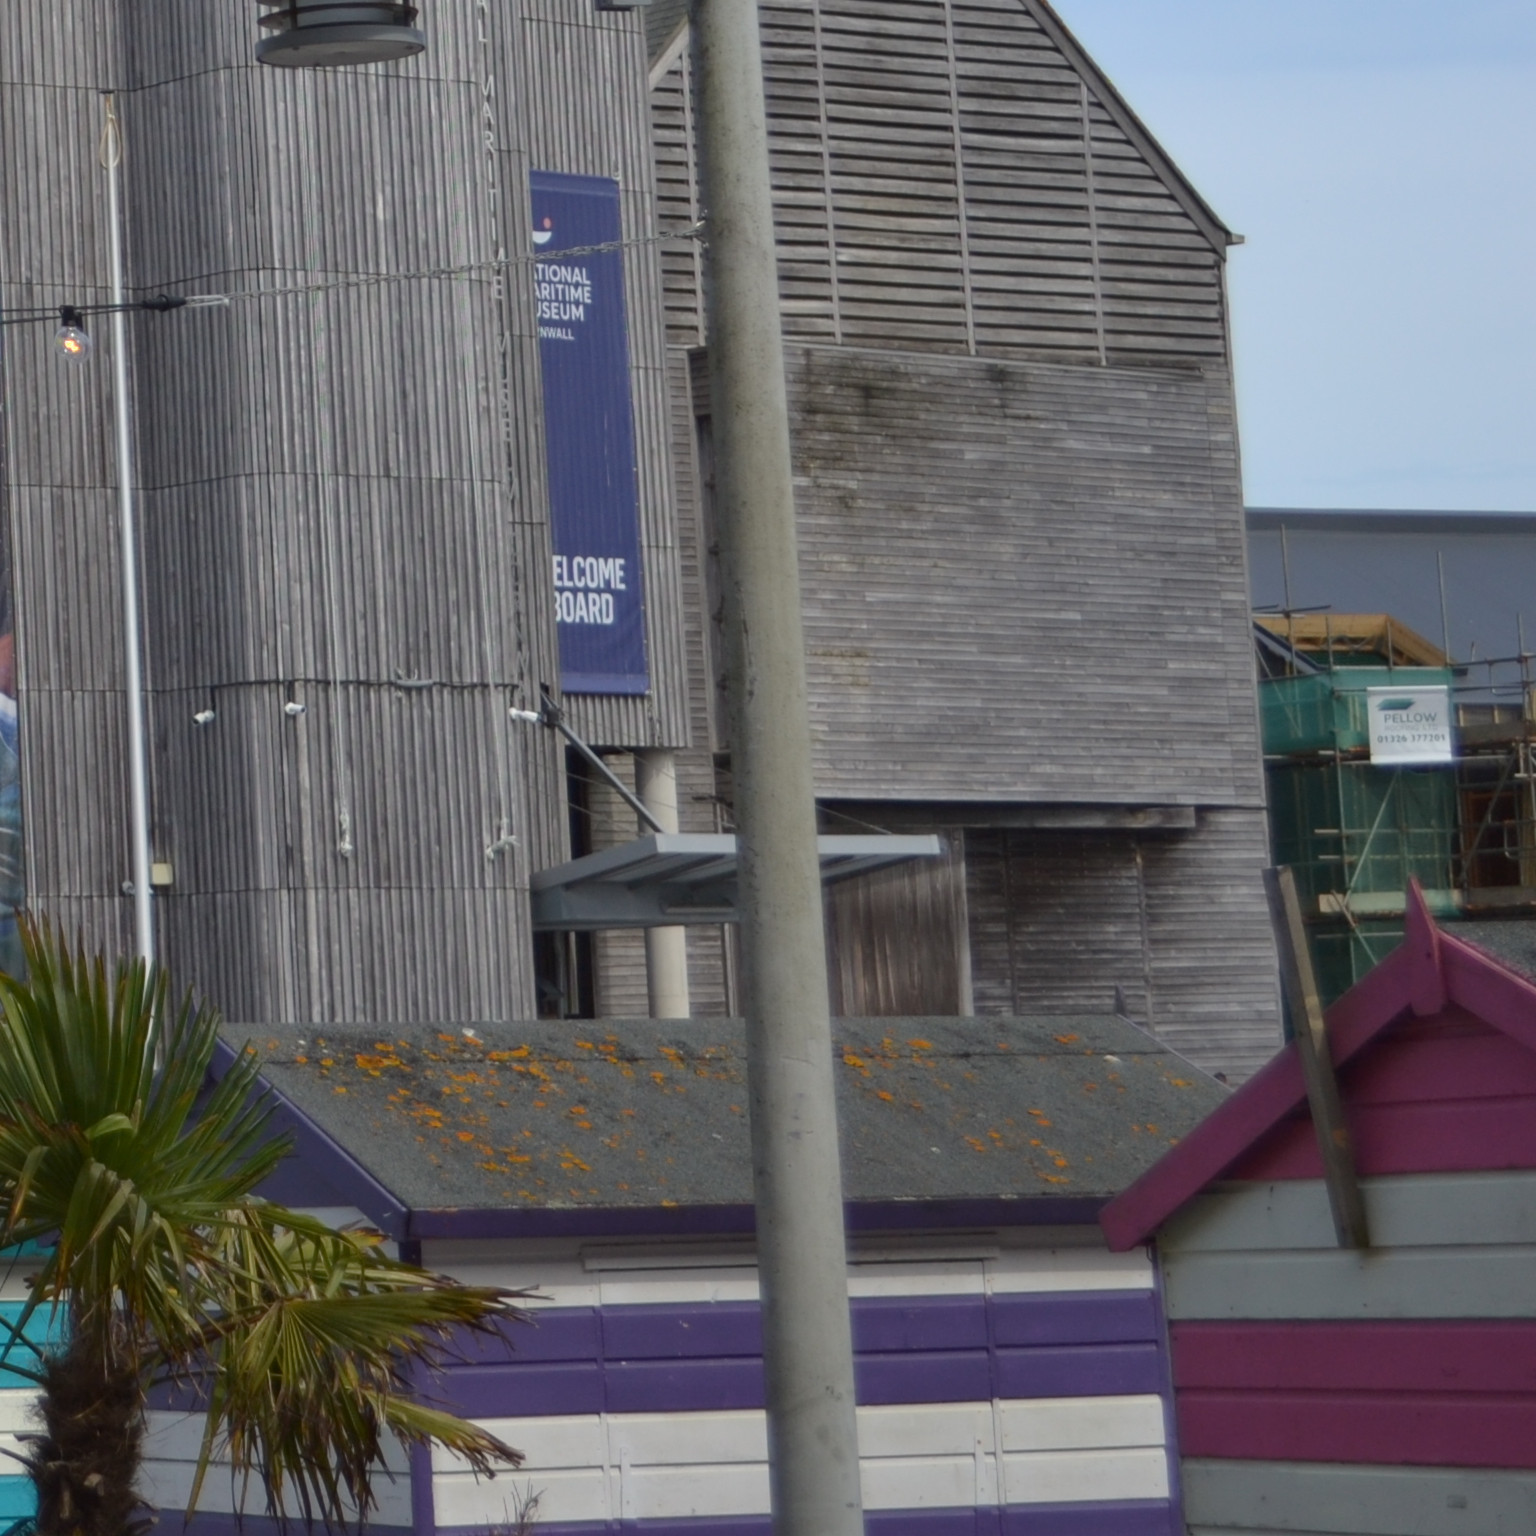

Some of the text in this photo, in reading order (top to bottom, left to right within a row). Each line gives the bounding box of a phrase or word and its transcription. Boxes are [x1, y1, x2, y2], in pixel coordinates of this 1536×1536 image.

[534, 264, 591, 285] TIONAL
[535, 283, 592, 304] ARITIME
[536, 302, 584, 321] USEUM
[539, 326, 575, 340] NWALL
[552, 555, 626, 590] ELCOME
[554, 591, 614, 624] BOARD
[1384, 713, 1437, 724] PELLOW
[1377, 735, 1407, 743] 01326
